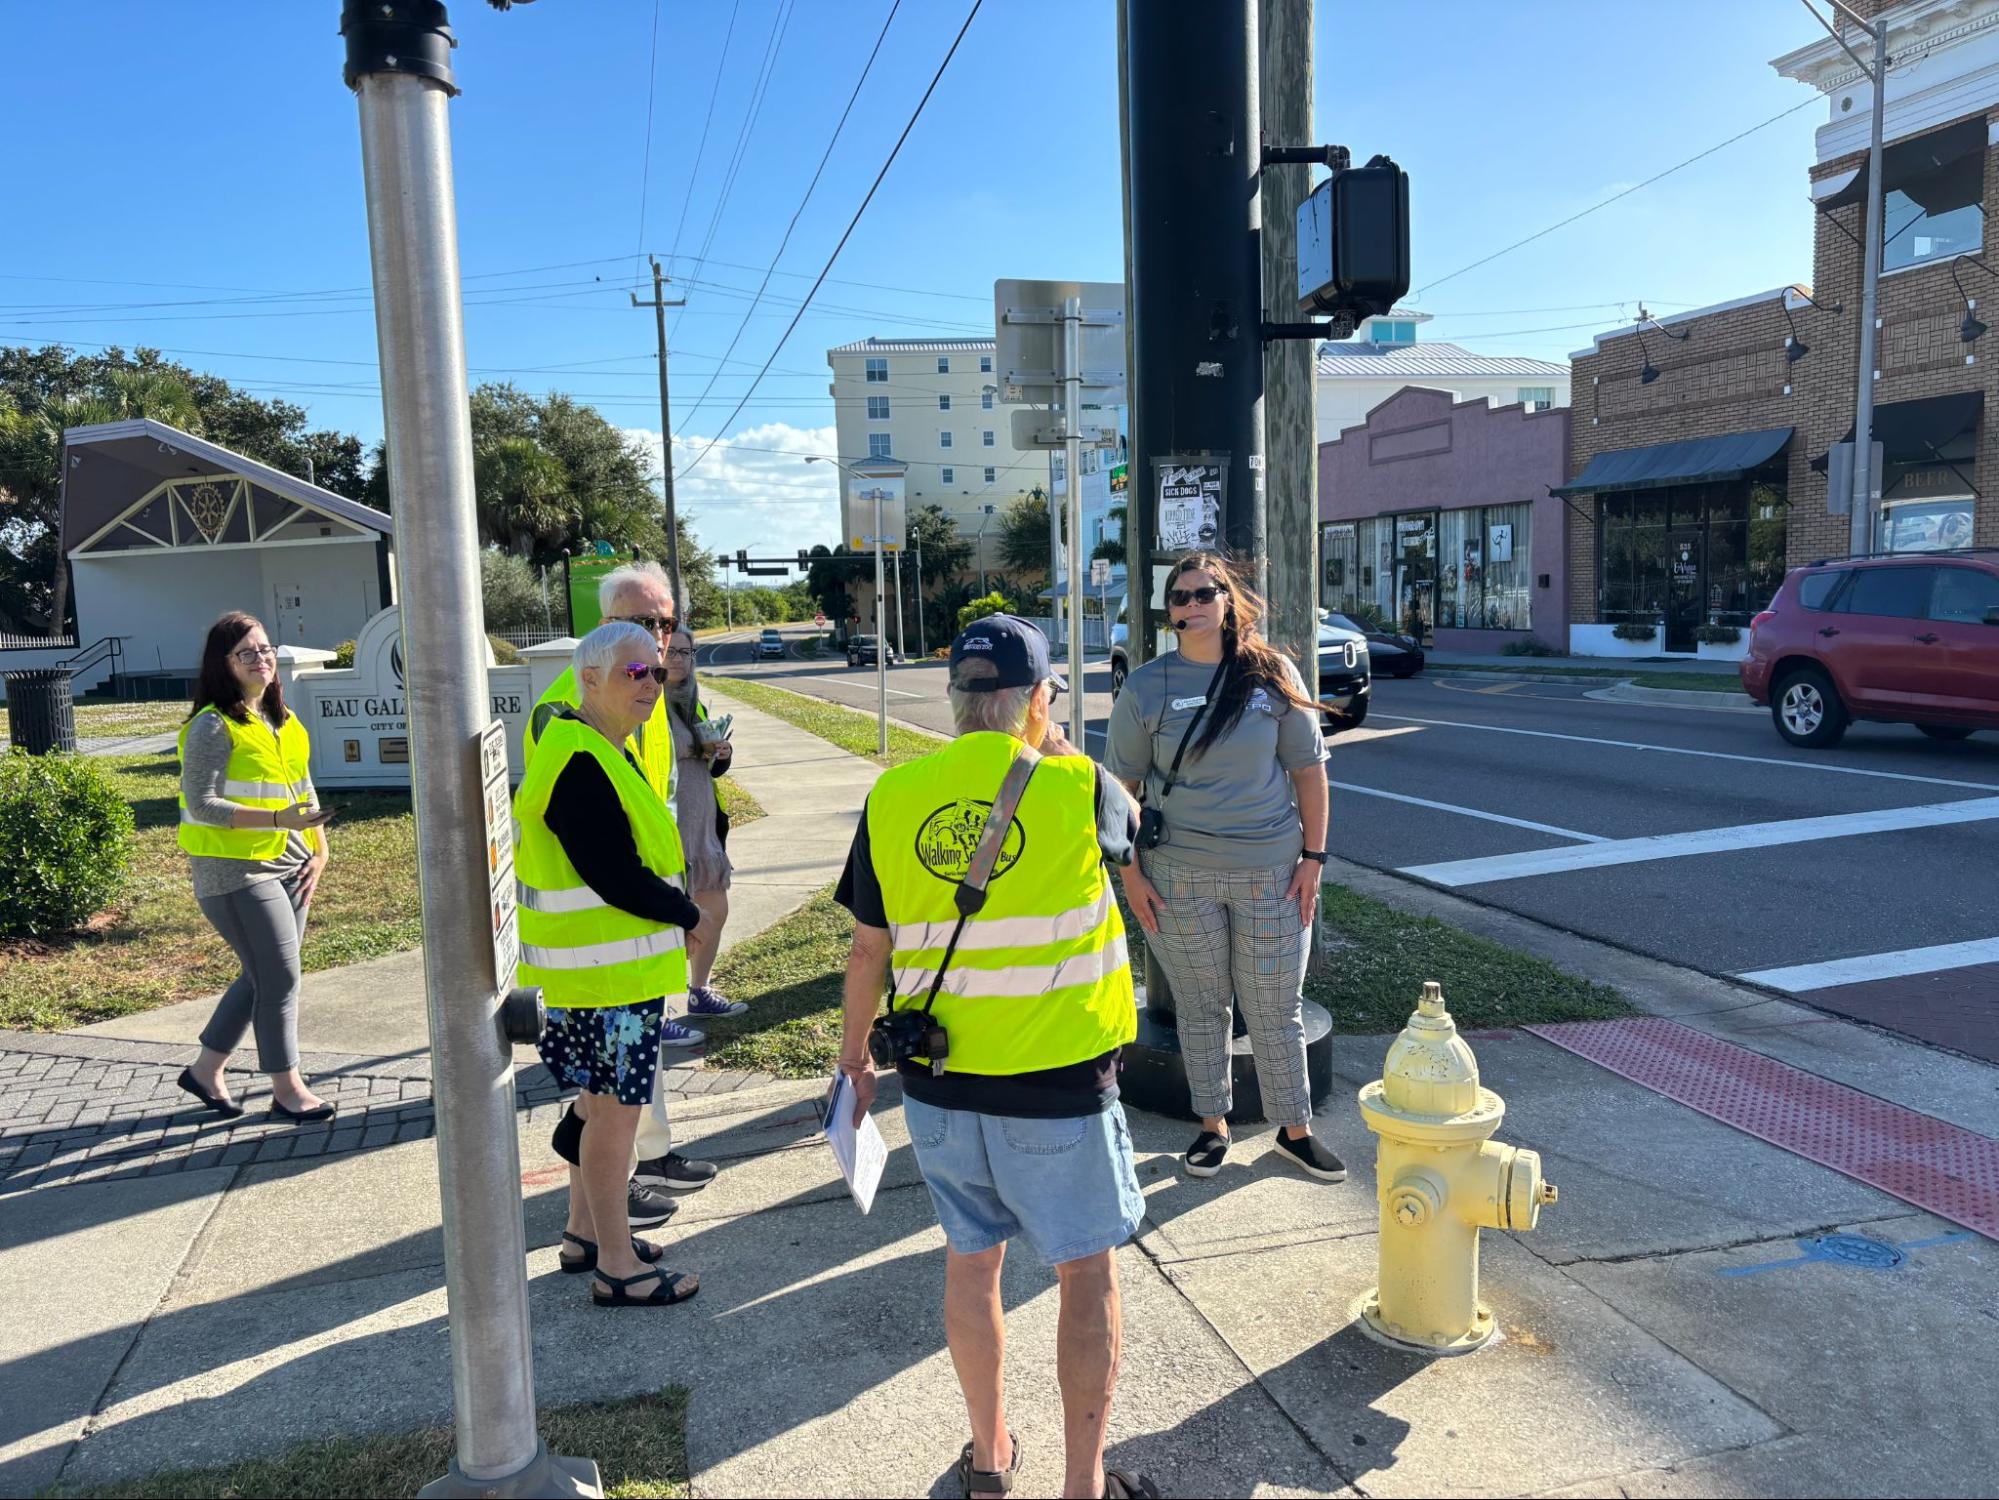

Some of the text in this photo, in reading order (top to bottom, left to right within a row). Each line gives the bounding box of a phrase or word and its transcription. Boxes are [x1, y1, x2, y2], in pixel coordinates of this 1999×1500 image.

[1904, 471, 1951, 488] BEER
[1164, 486, 1198, 496] SICK DOGS
[320, 699, 359, 717] EAU
[370, 722, 394, 731] CITY
[920, 841, 962, 870] Walking
